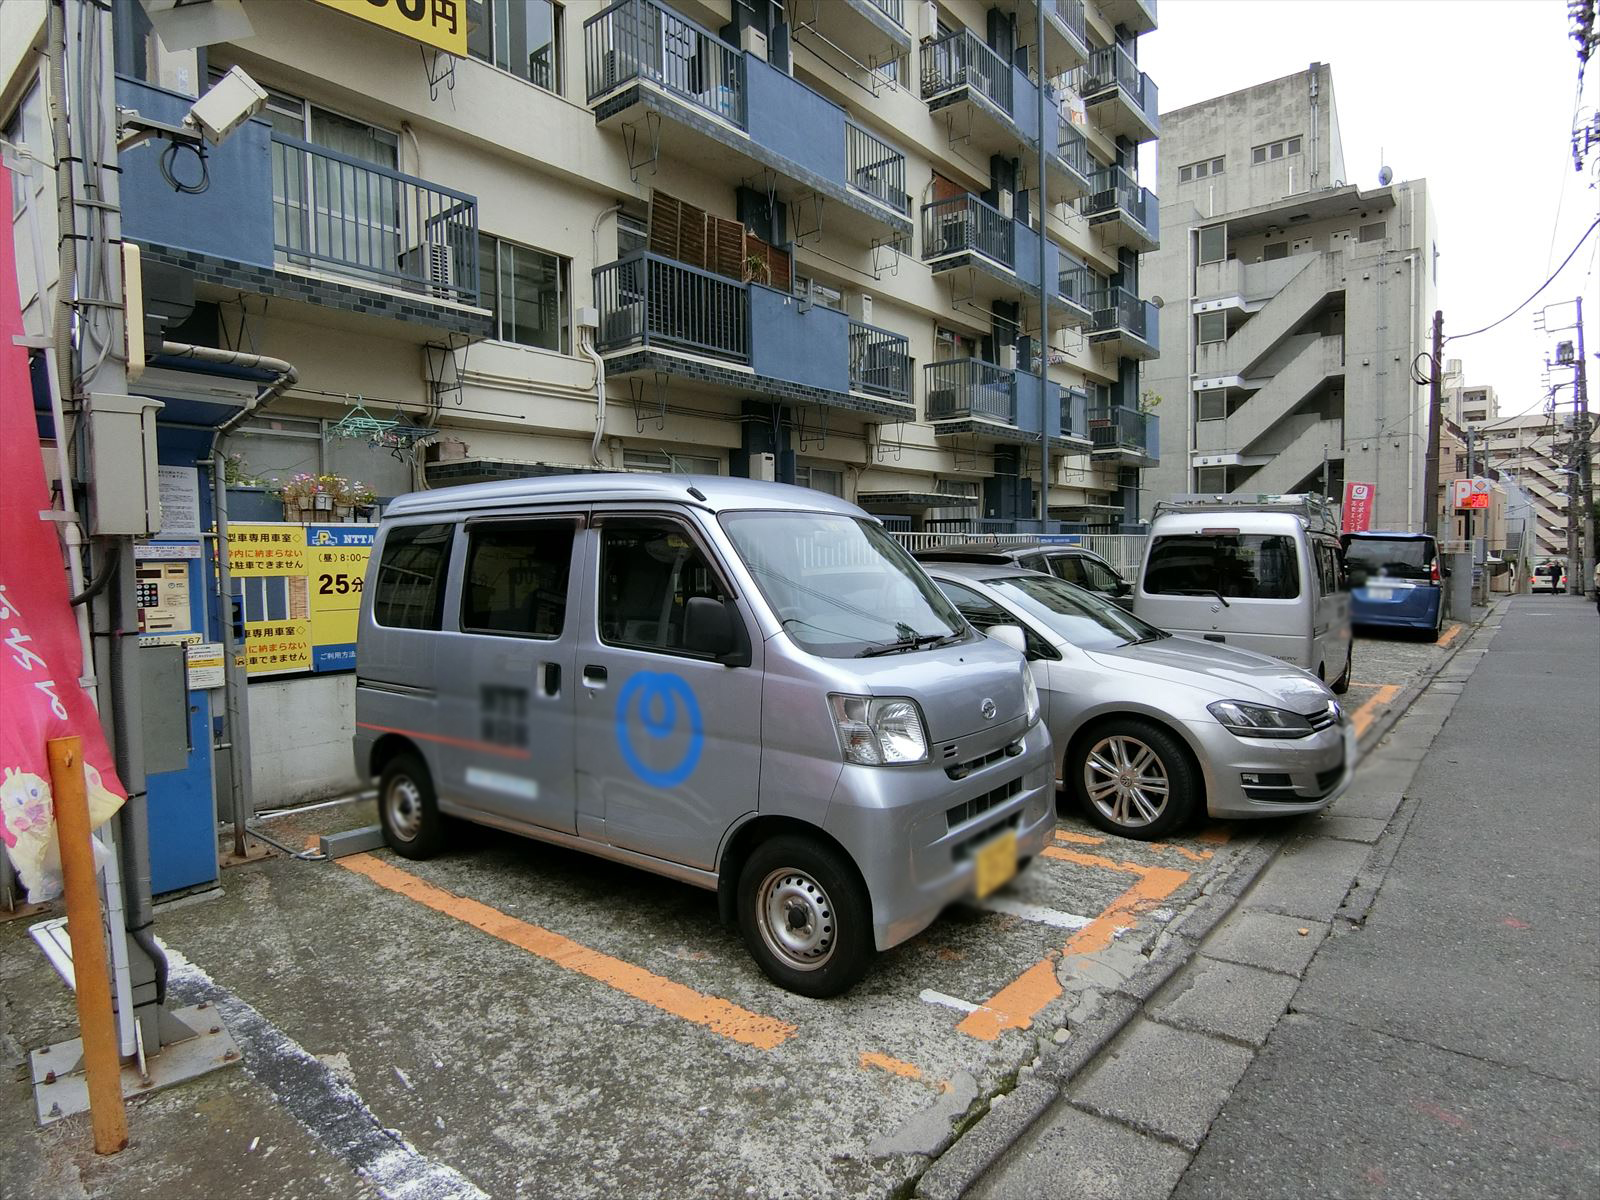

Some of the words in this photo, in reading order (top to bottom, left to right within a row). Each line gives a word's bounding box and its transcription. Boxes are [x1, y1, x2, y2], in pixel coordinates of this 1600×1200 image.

[245, 641, 307, 654] に納まらない
[246, 653, 307, 666] 車できません
